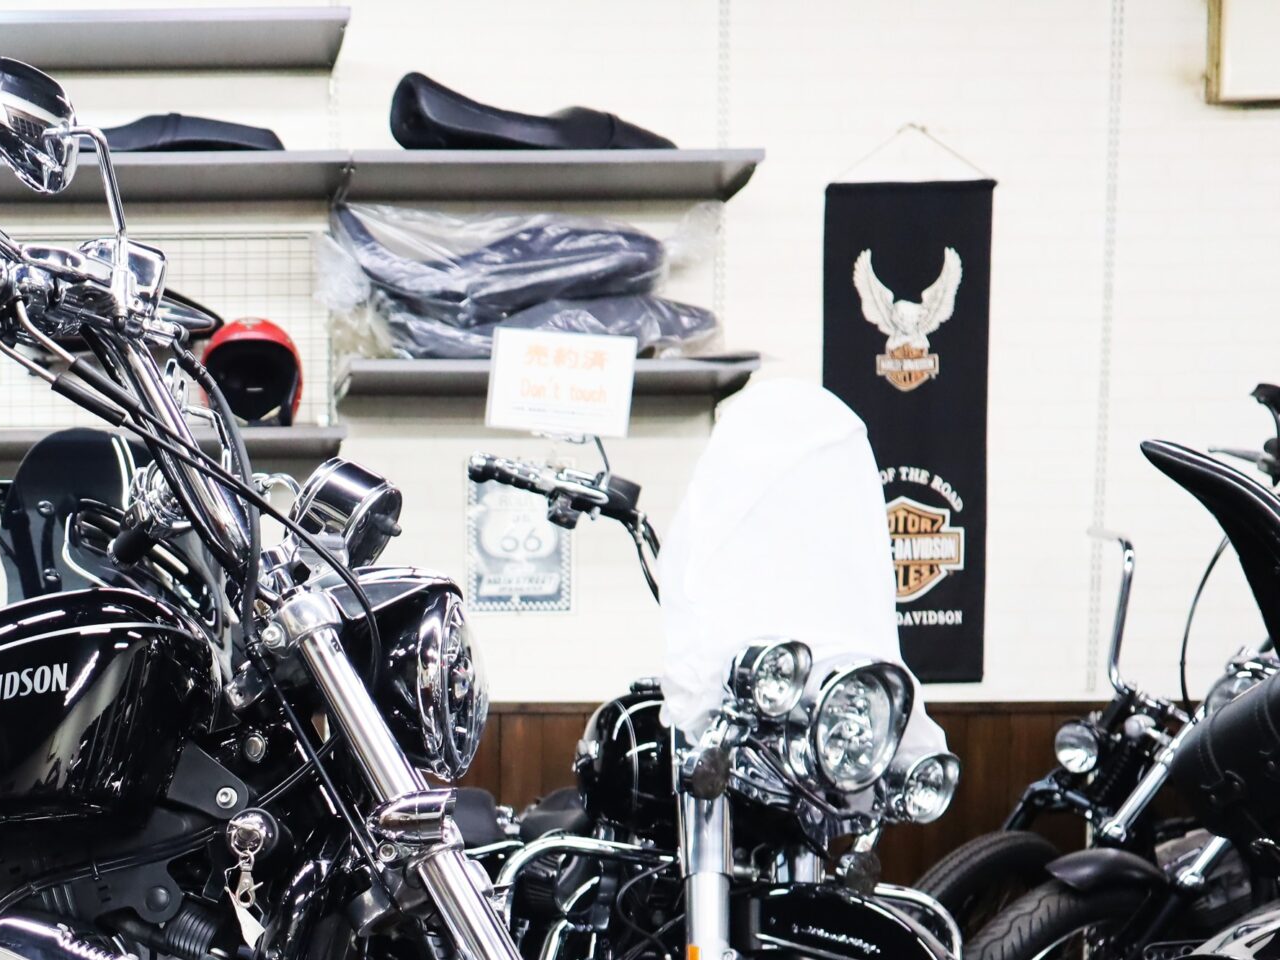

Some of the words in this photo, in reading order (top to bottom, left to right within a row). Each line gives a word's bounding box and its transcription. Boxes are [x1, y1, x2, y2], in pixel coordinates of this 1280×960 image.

[519, 376, 561, 400] Don't
[570, 383, 609, 403] touch
[878, 466, 896, 485] OF
[899, 466, 930, 485] THE
[930, 474, 964, 513] ROAD
[500, 527, 542, 553] 66
[891, 537, 956, 561] -DAVIDSON
